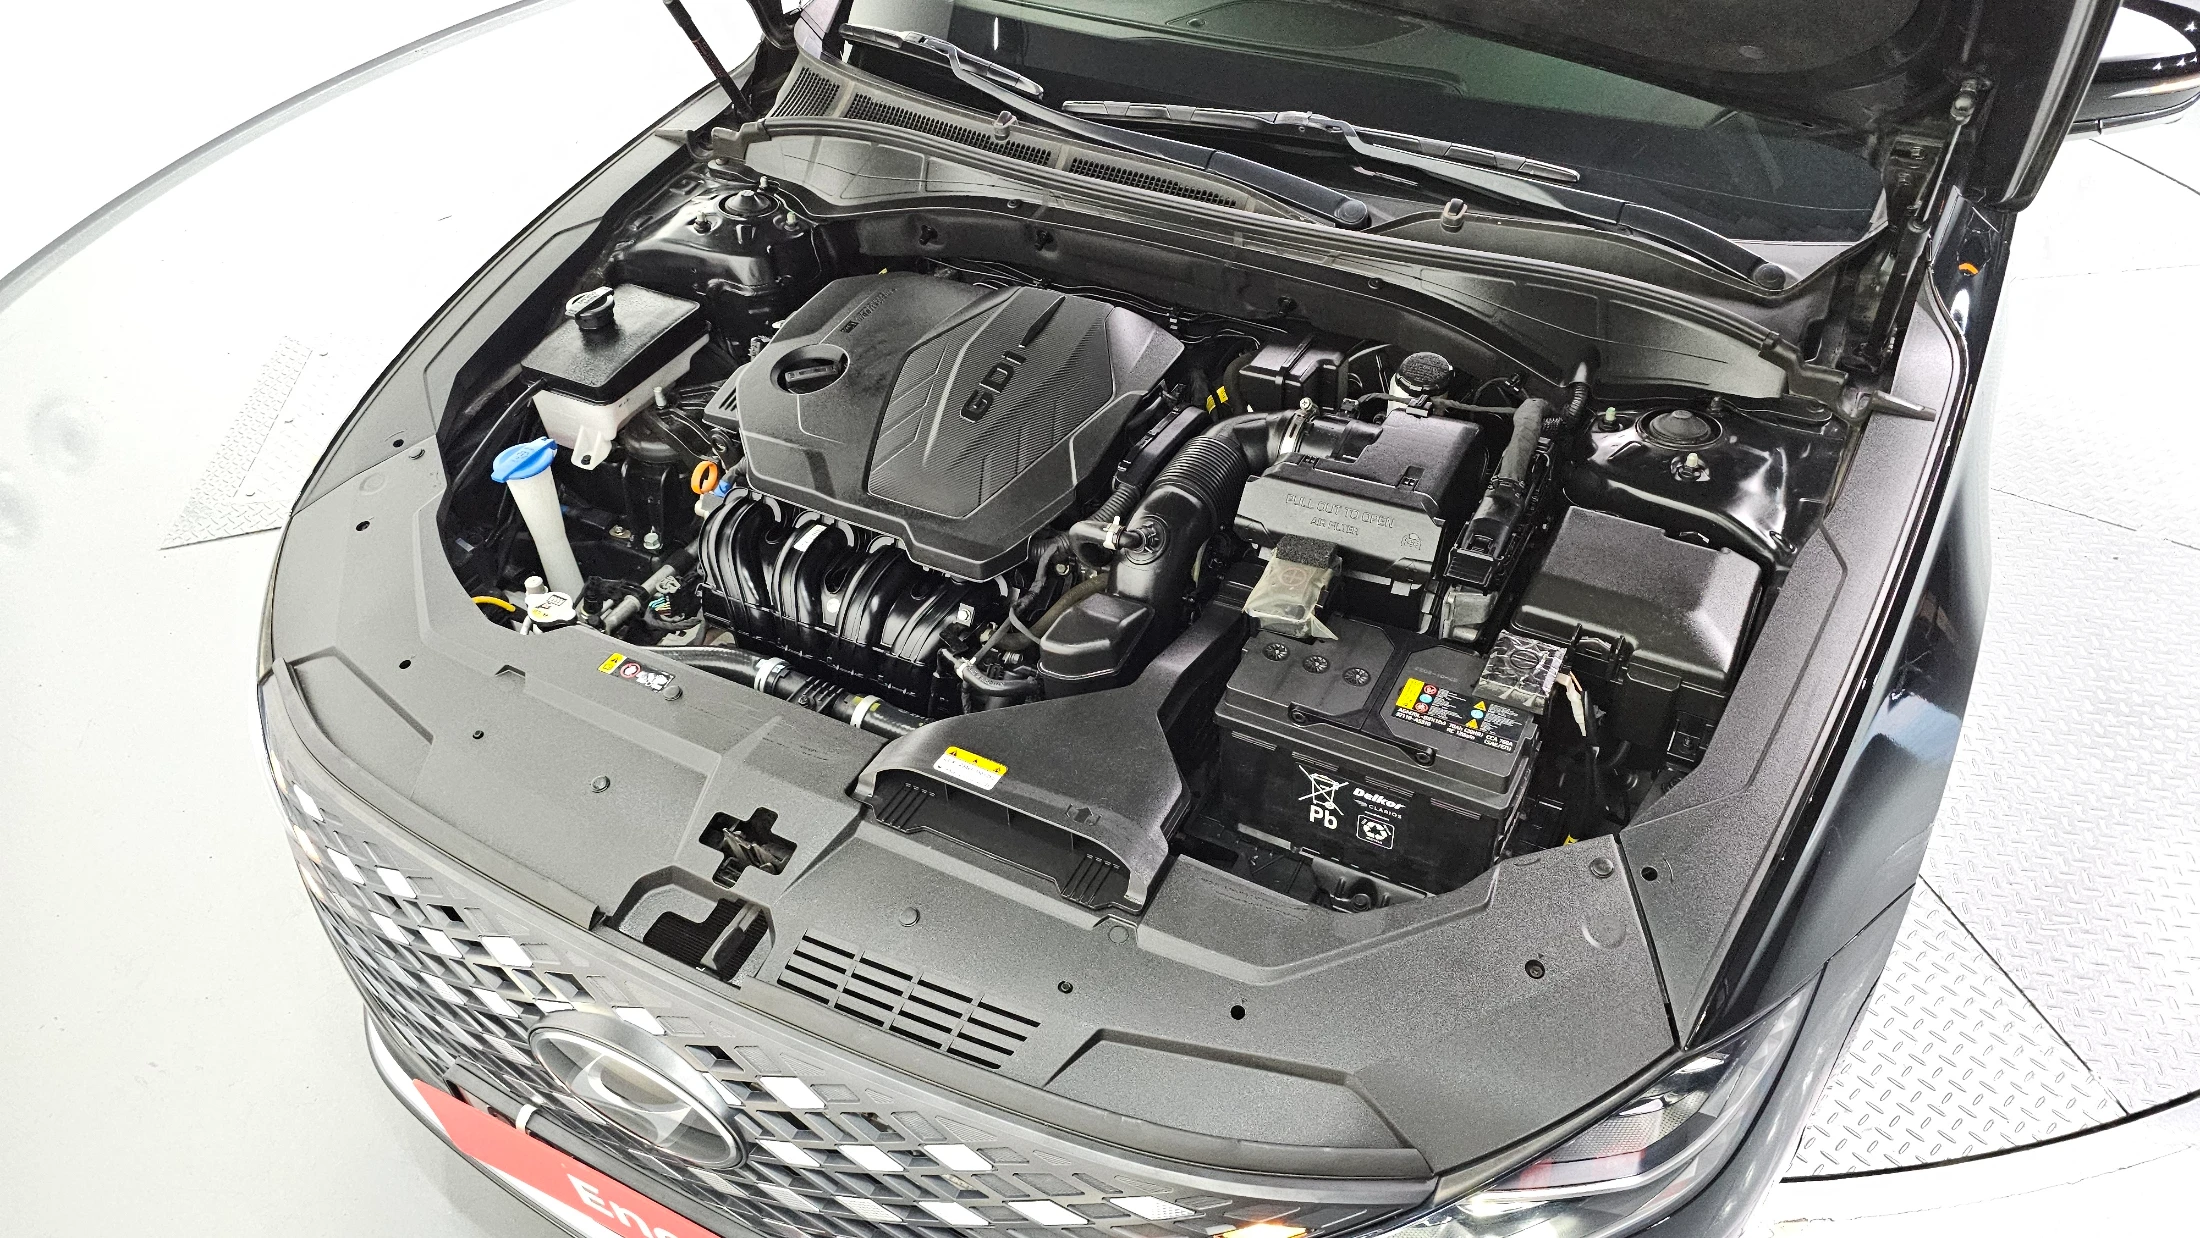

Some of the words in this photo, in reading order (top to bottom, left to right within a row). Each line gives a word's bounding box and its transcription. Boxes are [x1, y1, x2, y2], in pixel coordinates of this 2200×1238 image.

[1285, 493, 1314, 509] PULL
[1316, 501, 1342, 515] OUT
[1344, 507, 1360, 520] TO
[1361, 512, 1395, 528] OPEN
[1310, 517, 1326, 527] AIR
[1328, 520, 1359, 536] FILTER
[1485, 734, 1498, 742] CCA
[1353, 787, 1406, 810] Delkor
[1309, 804, 1338, 830] Pb
[1368, 804, 1402, 819] CLARIOS
